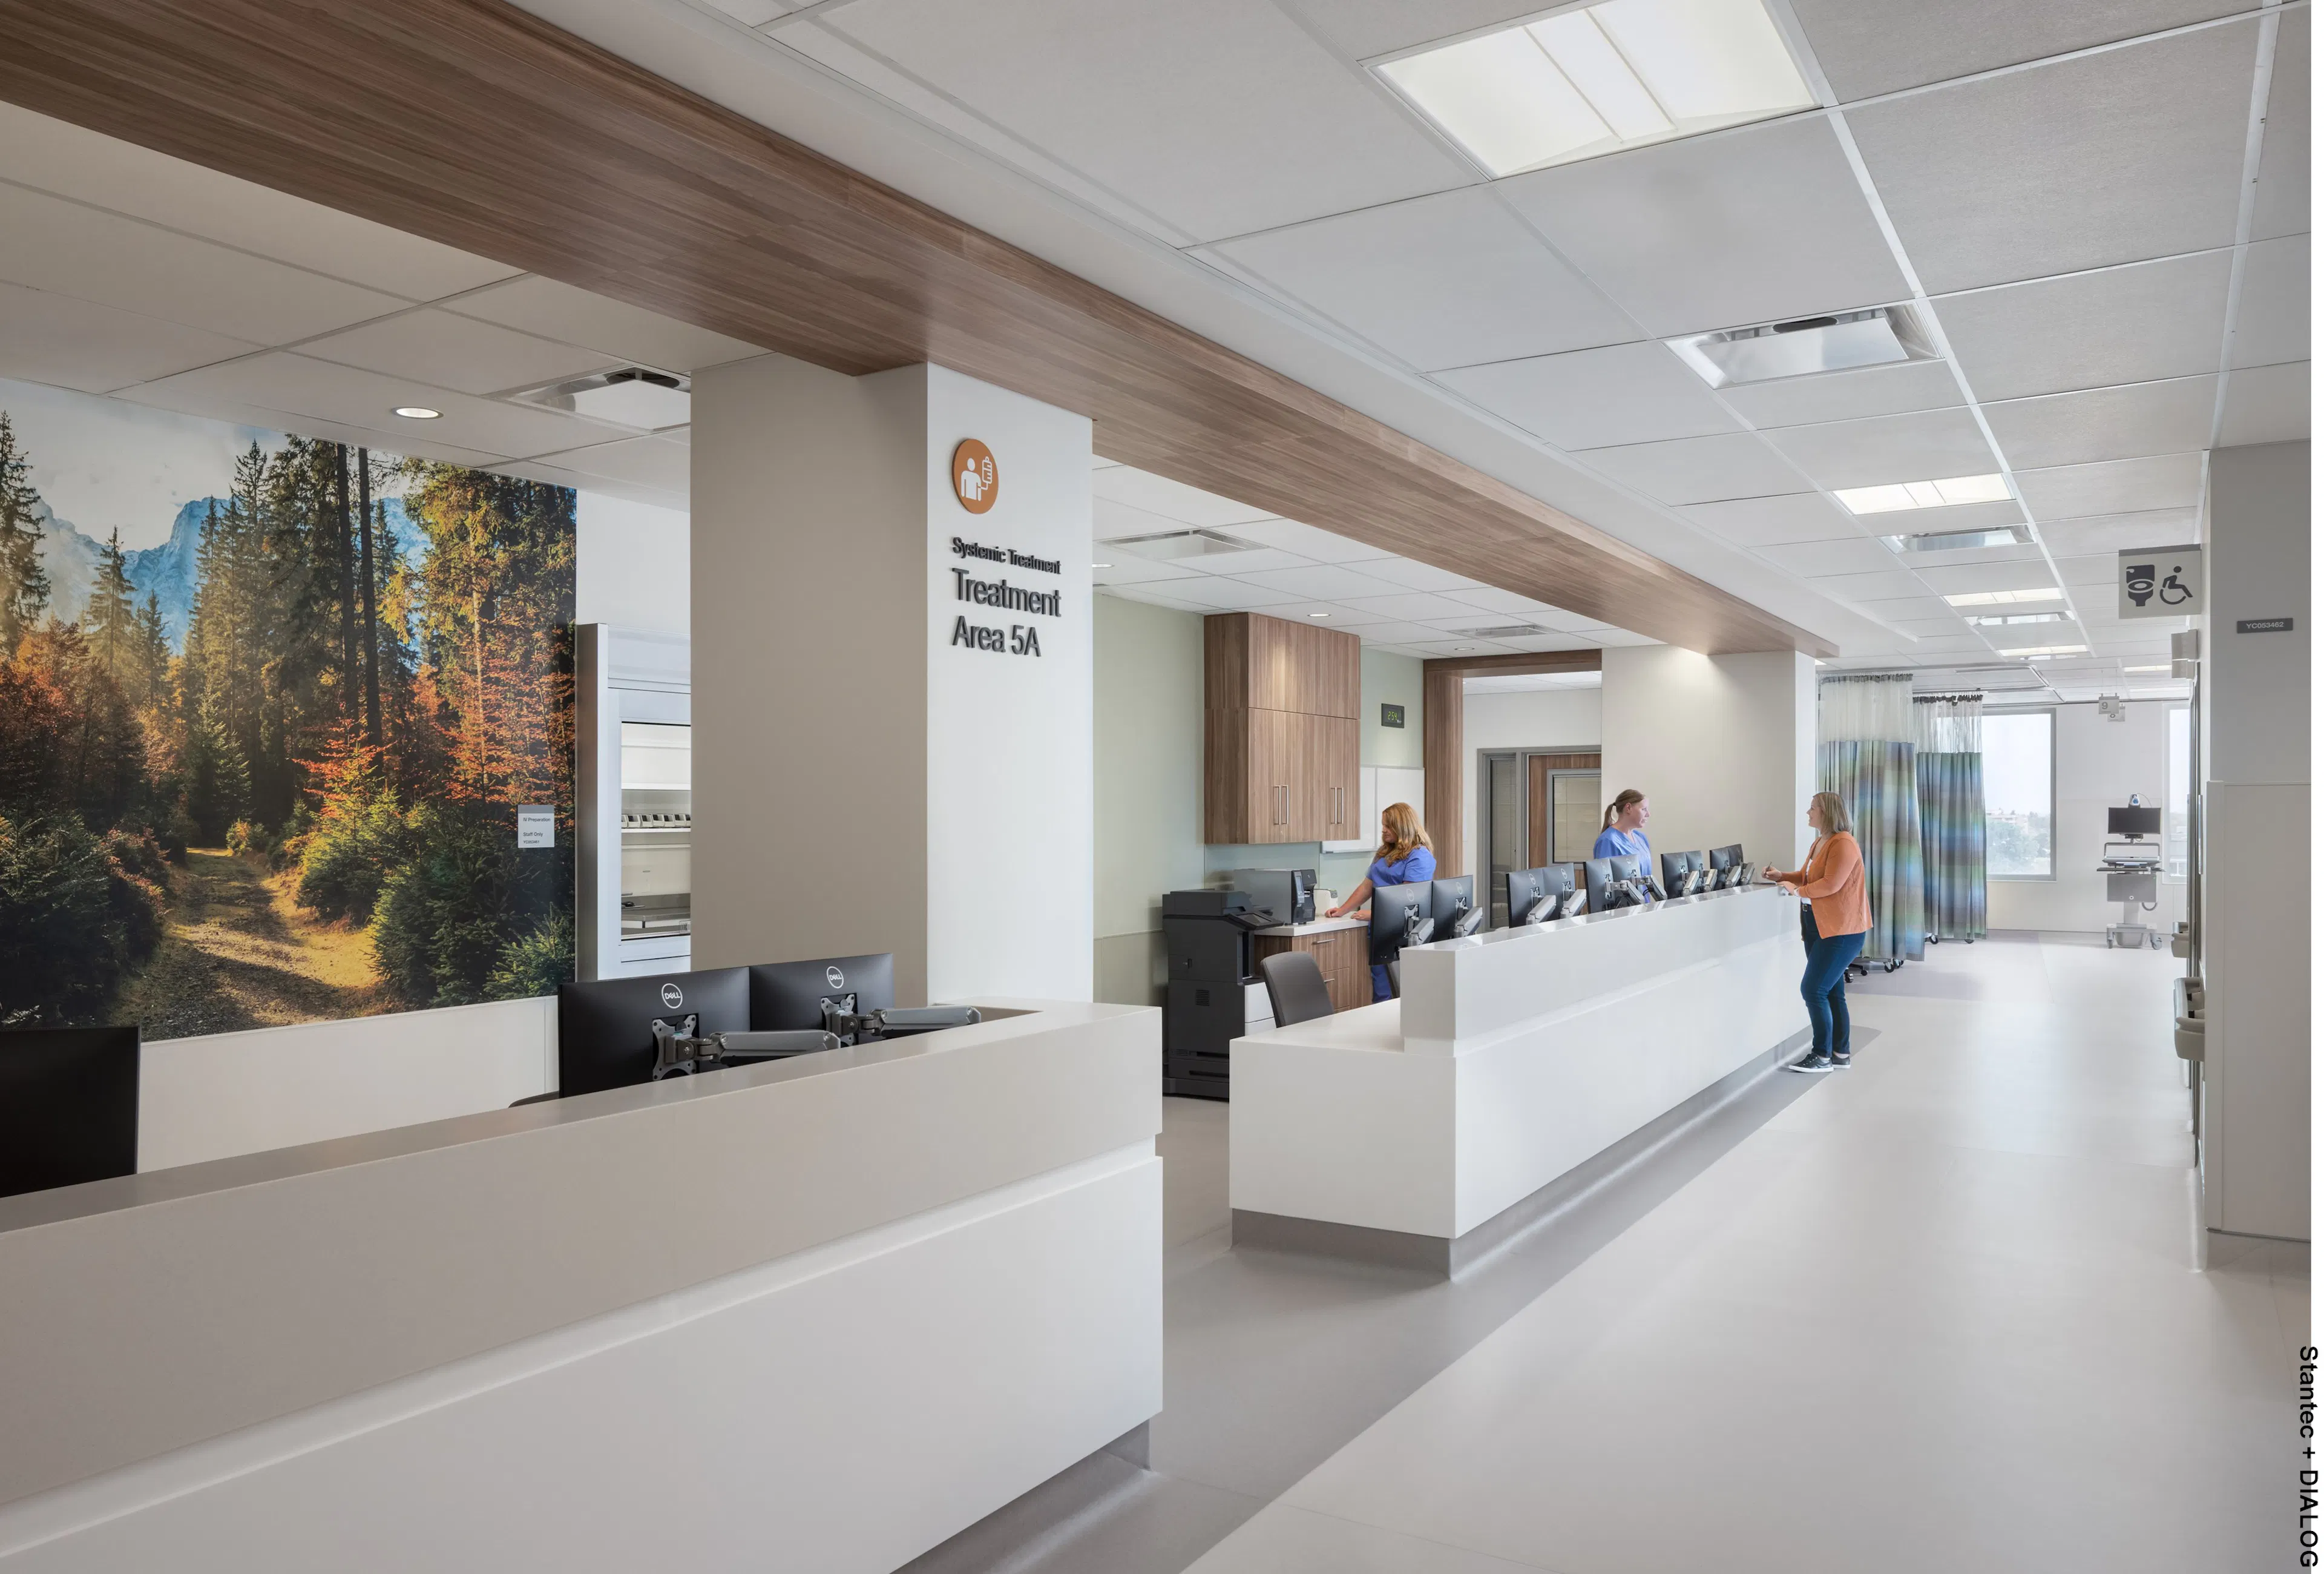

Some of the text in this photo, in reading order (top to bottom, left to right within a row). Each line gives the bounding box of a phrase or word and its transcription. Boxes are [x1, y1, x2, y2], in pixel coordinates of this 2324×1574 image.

[952, 536, 1062, 575] Systemic Treatment
[951, 567, 1062, 617] Treatment
[952, 615, 1042, 657] Area 5A
[2246, 621, 2285, 630] YC053462
